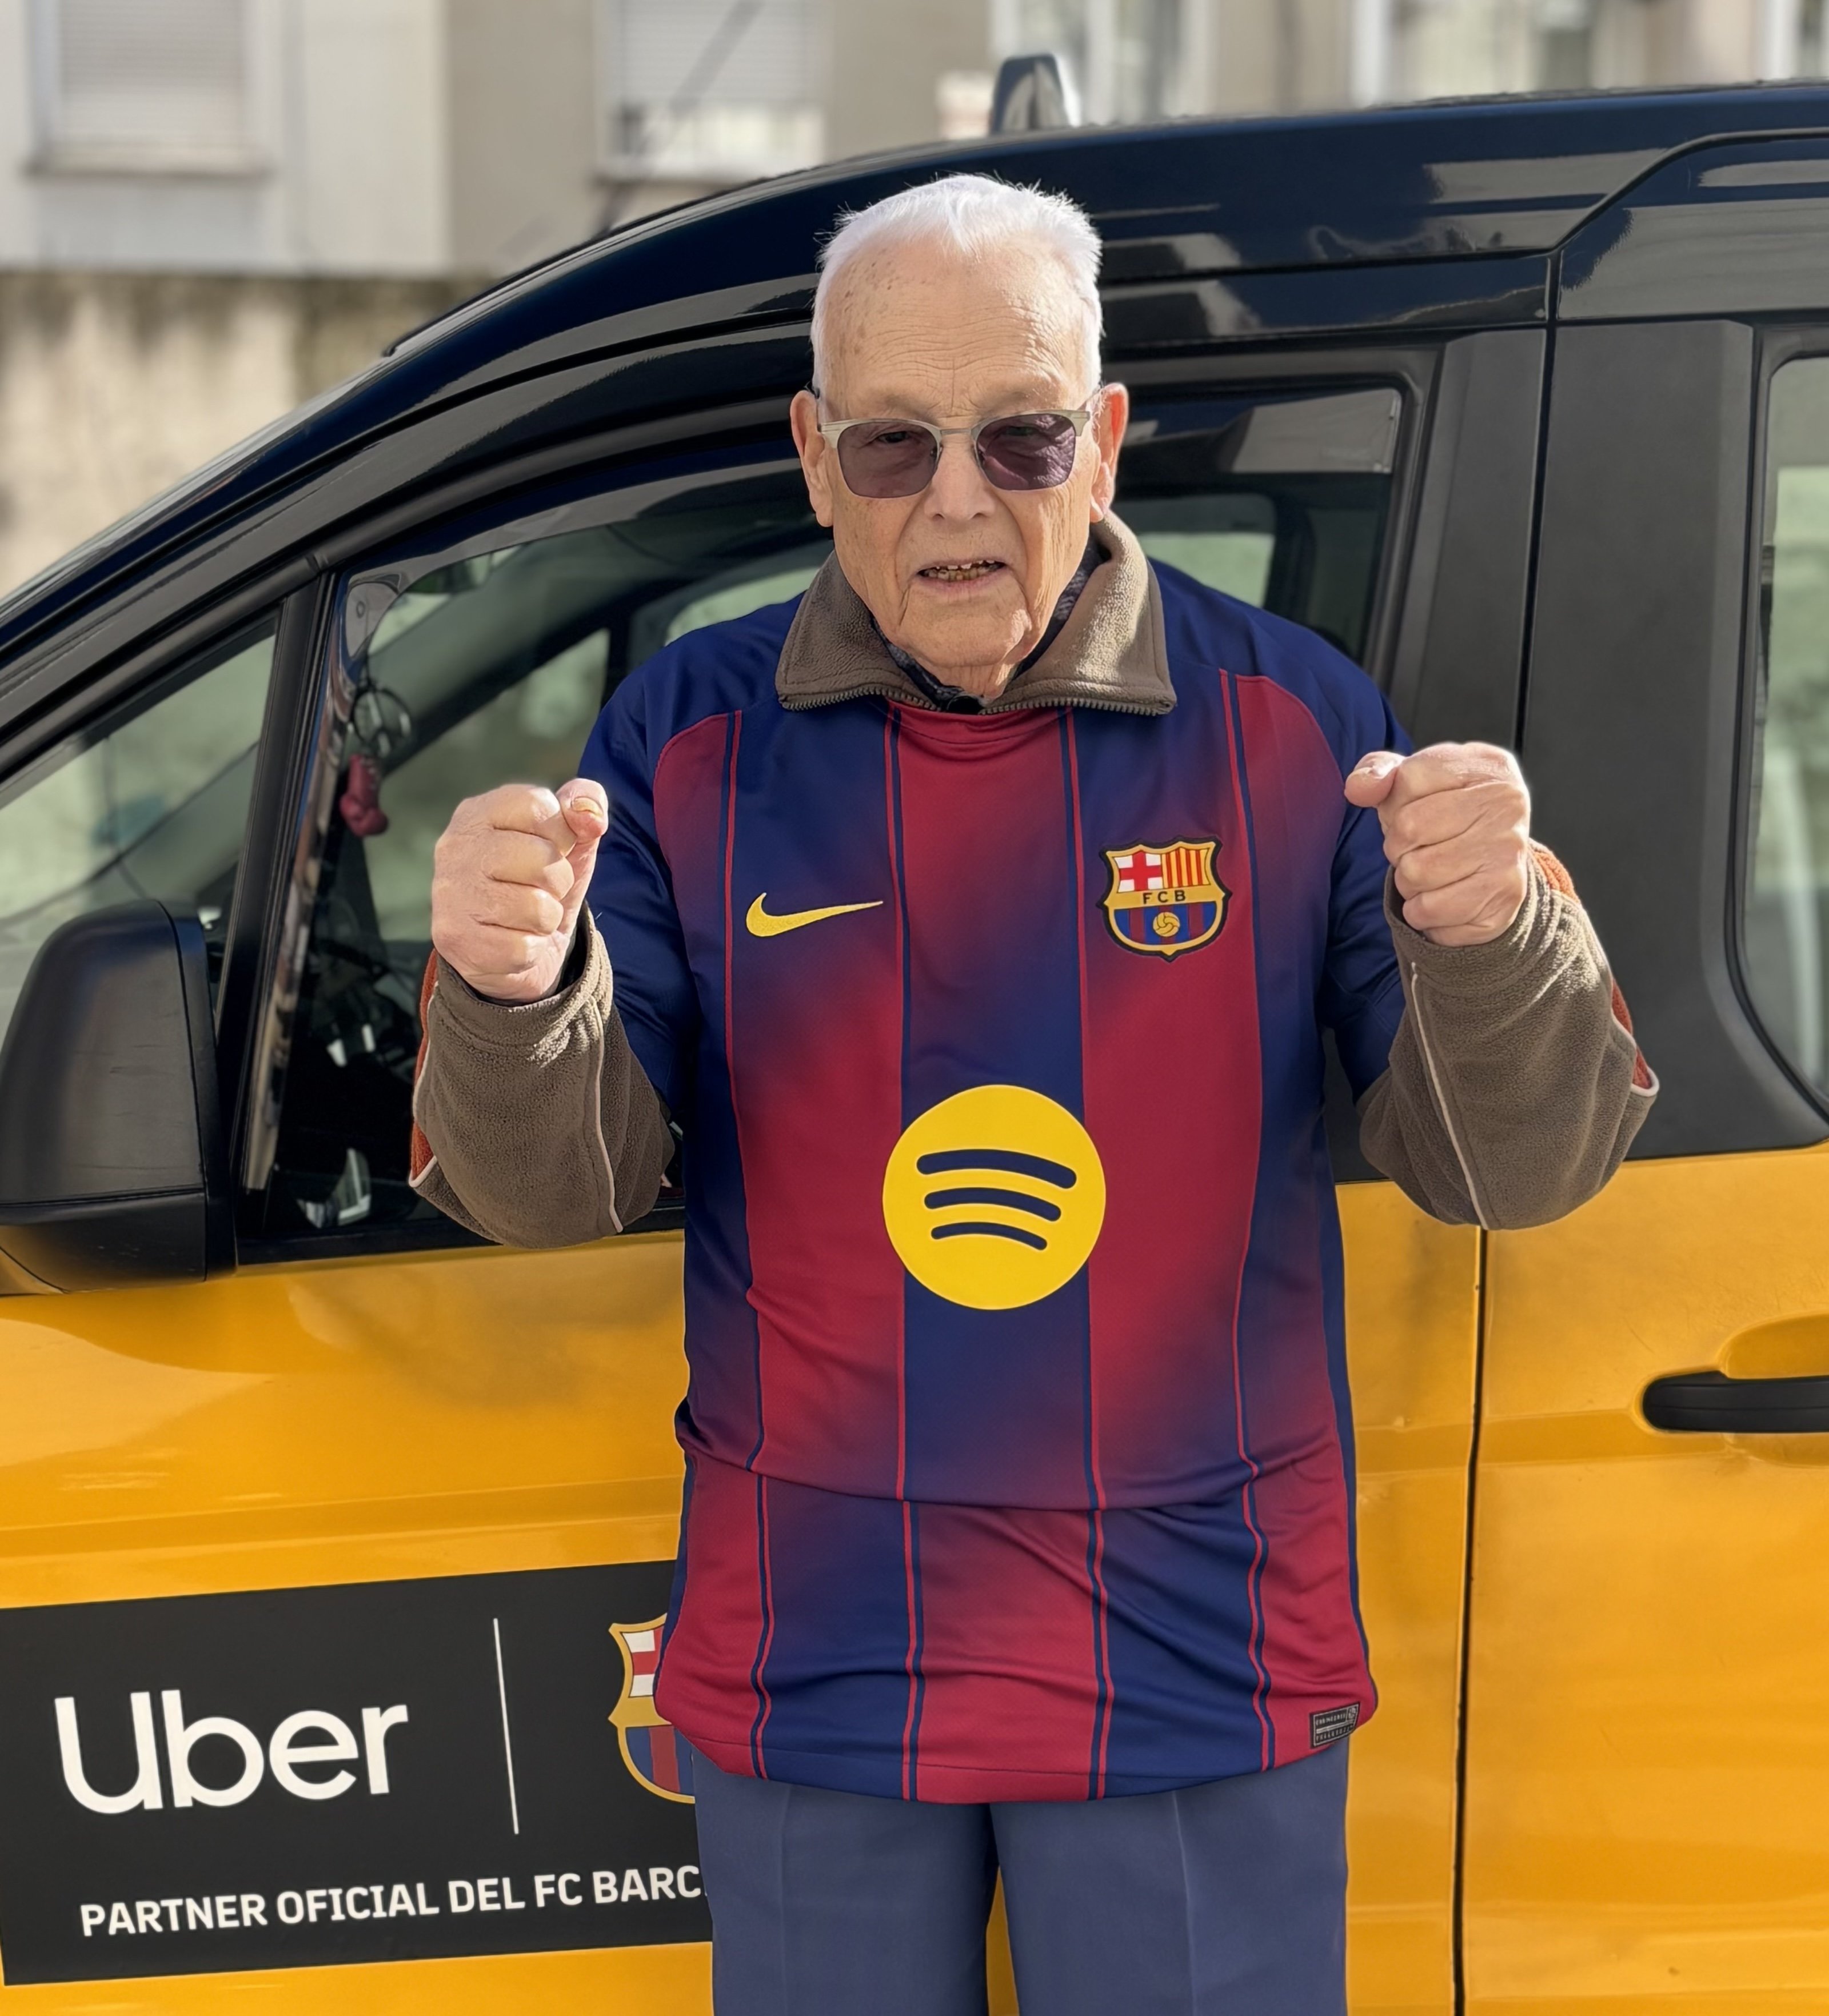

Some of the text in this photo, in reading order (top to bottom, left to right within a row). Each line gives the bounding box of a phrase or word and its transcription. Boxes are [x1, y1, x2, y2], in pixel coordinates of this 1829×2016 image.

[54, 1689, 409, 1814] Uber
[80, 1865, 707, 1937] PARTNER OFICIAL DEL FC BARC
